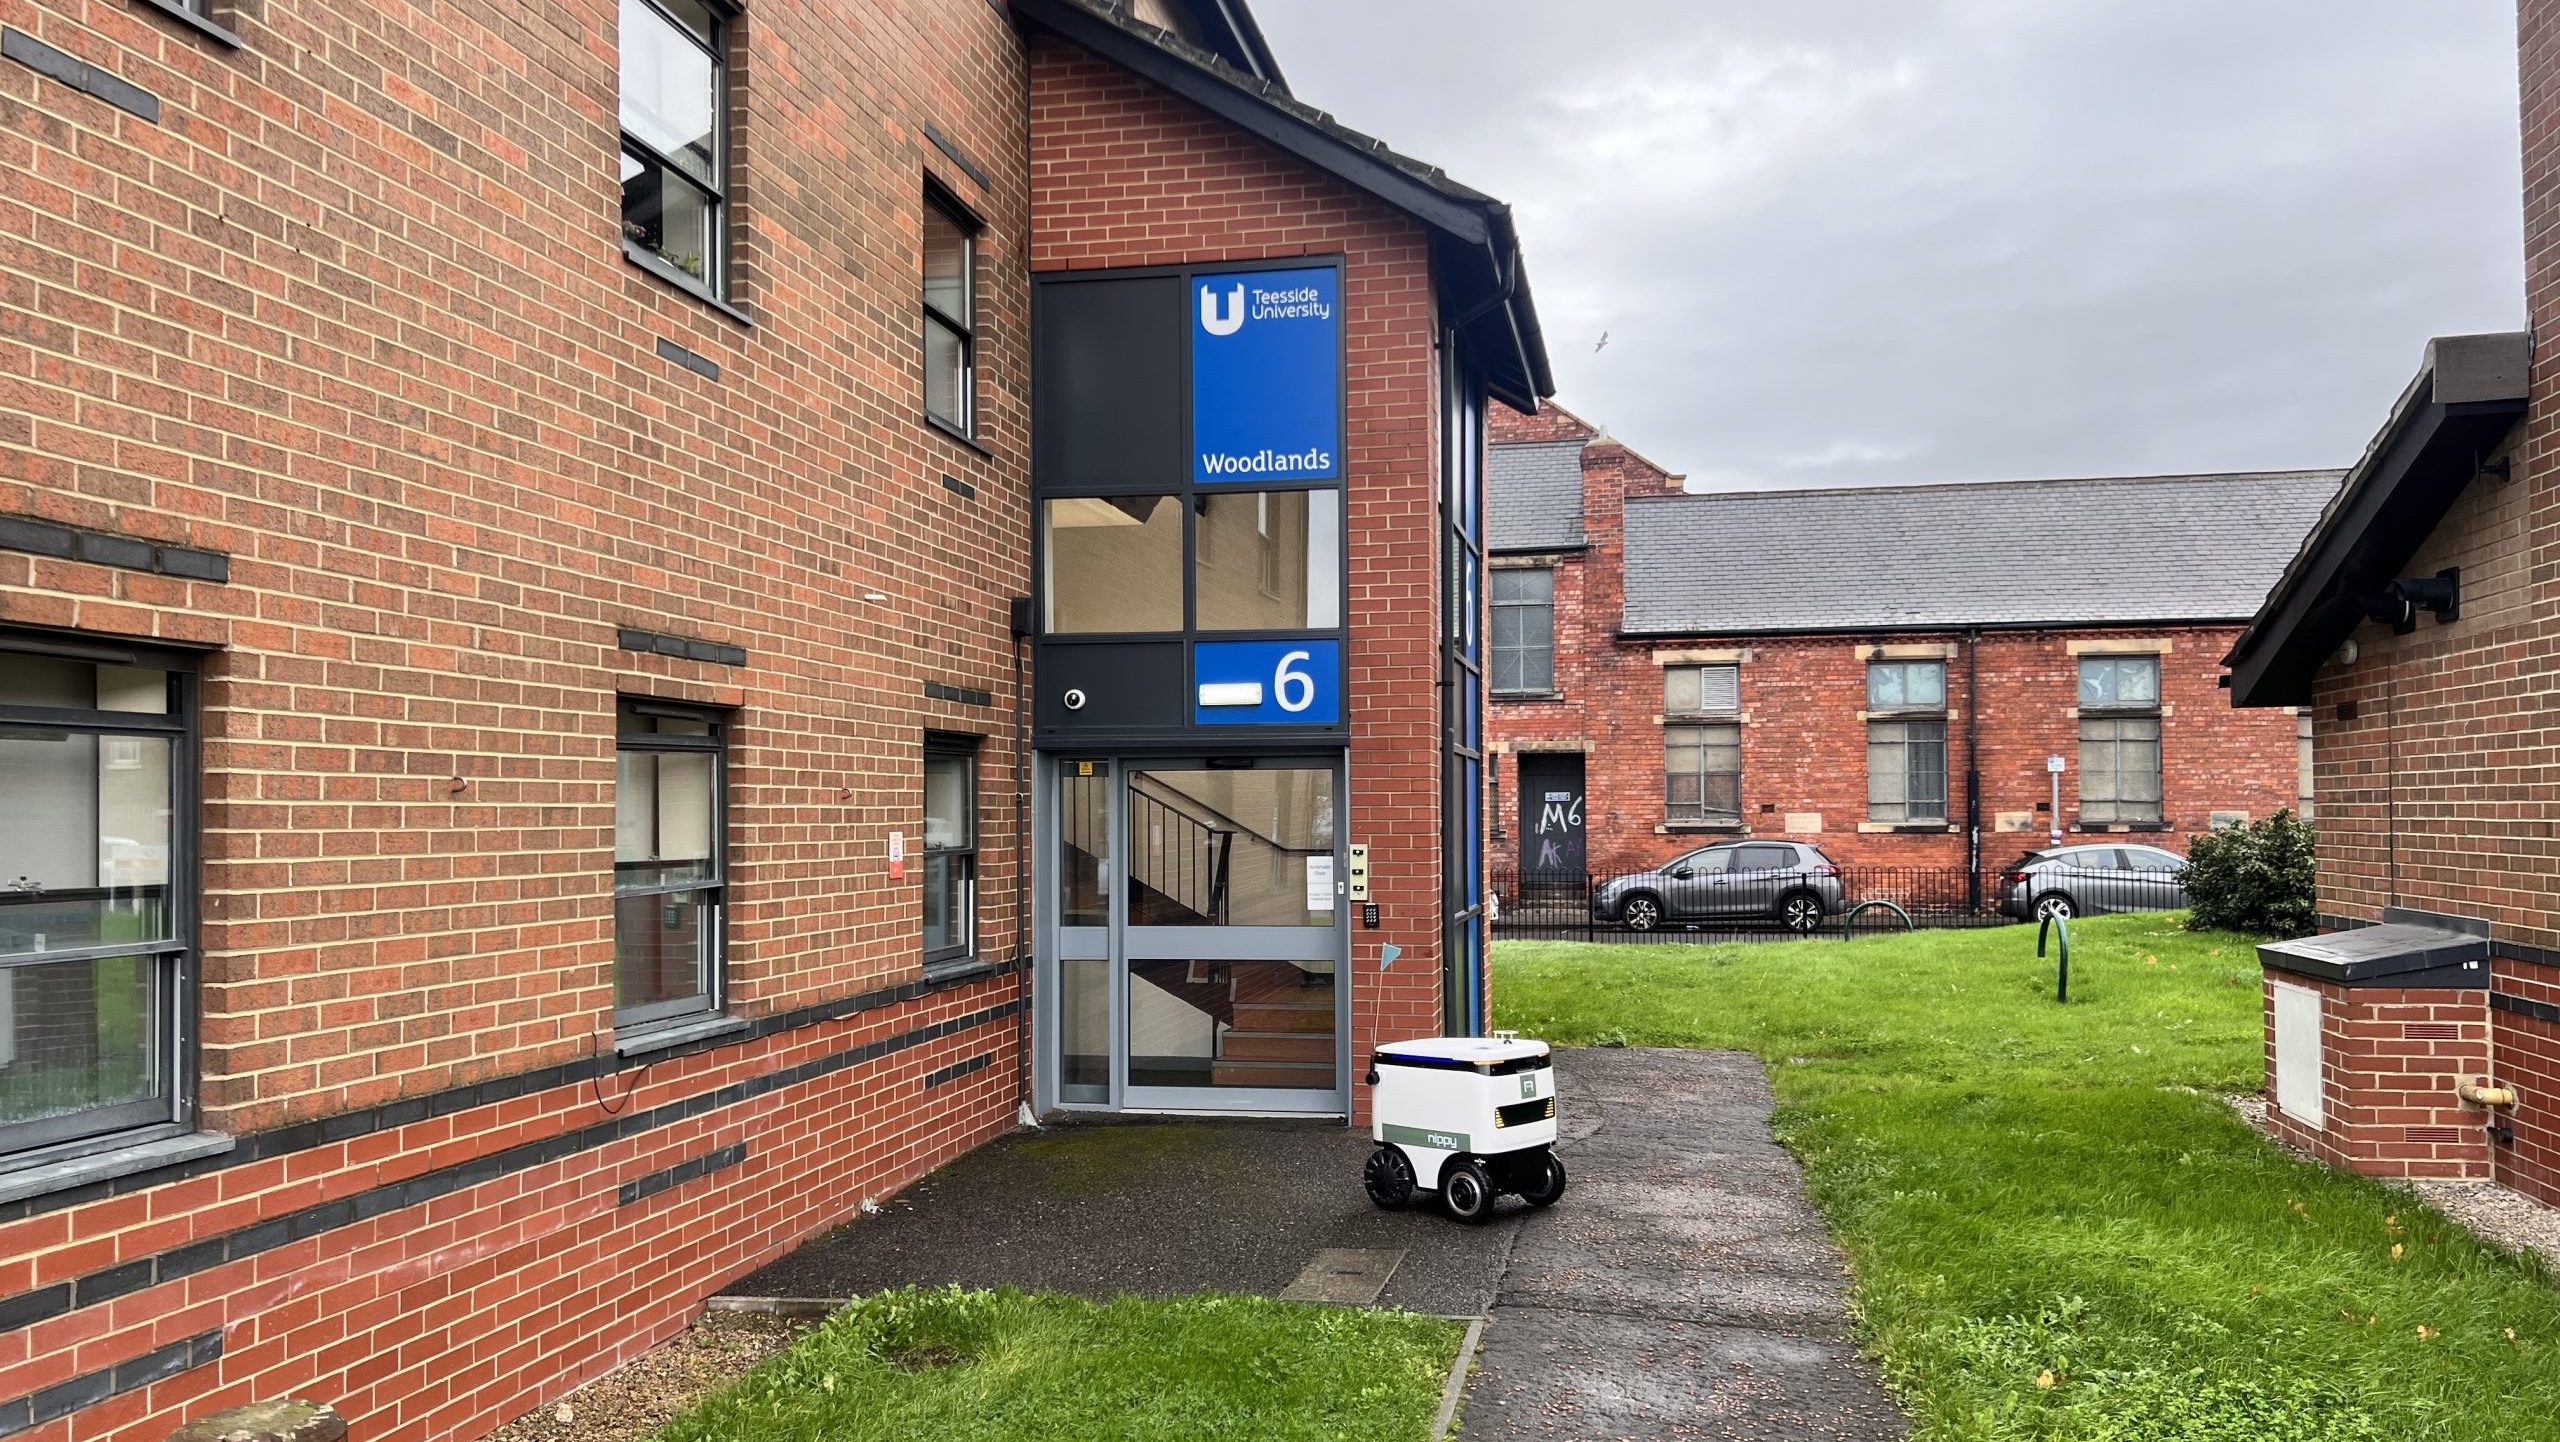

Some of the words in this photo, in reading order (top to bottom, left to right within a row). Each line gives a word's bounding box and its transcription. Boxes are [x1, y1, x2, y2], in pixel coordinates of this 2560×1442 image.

[1252, 287, 1318, 304] Teesside
[1252, 303, 1329, 319] University
[1202, 448, 1330, 474] Woodlands
[1274, 651, 1314, 712] 6
[1428, 1133, 1457, 1149] nippy
